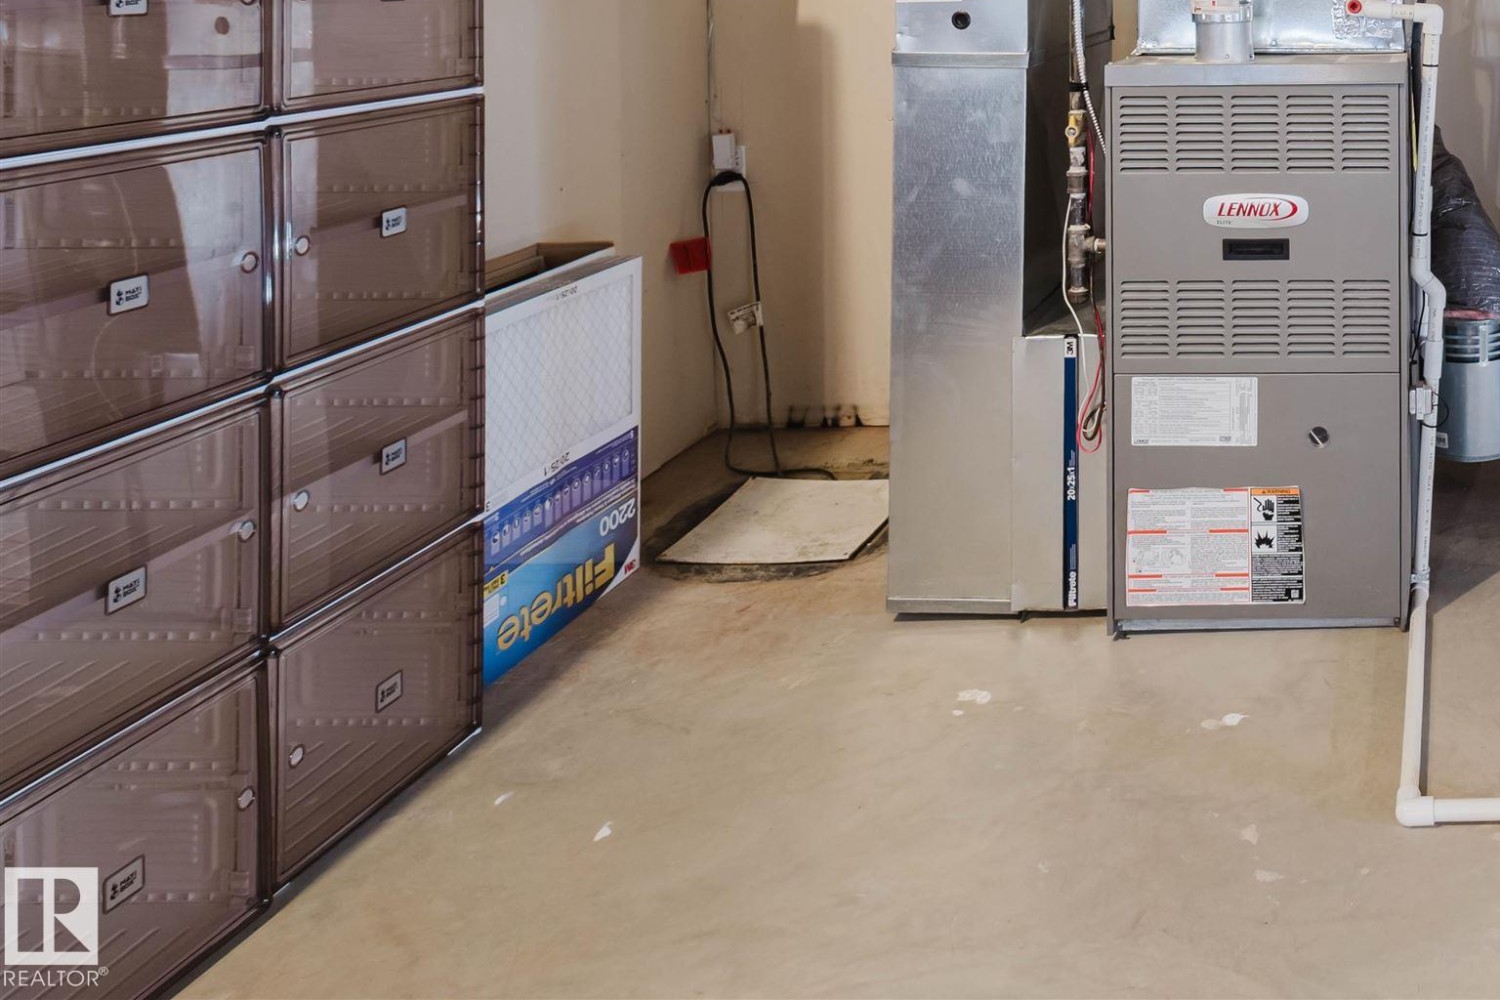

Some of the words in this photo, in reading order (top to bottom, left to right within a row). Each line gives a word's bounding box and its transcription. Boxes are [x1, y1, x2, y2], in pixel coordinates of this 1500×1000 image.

[1217, 202, 1282, 217] LENNOX
[1066, 341, 1074, 355] 3M
[599, 497, 637, 537] 2200
[624, 558, 638, 575] 3M
[496, 542, 616, 651] Filtrete
